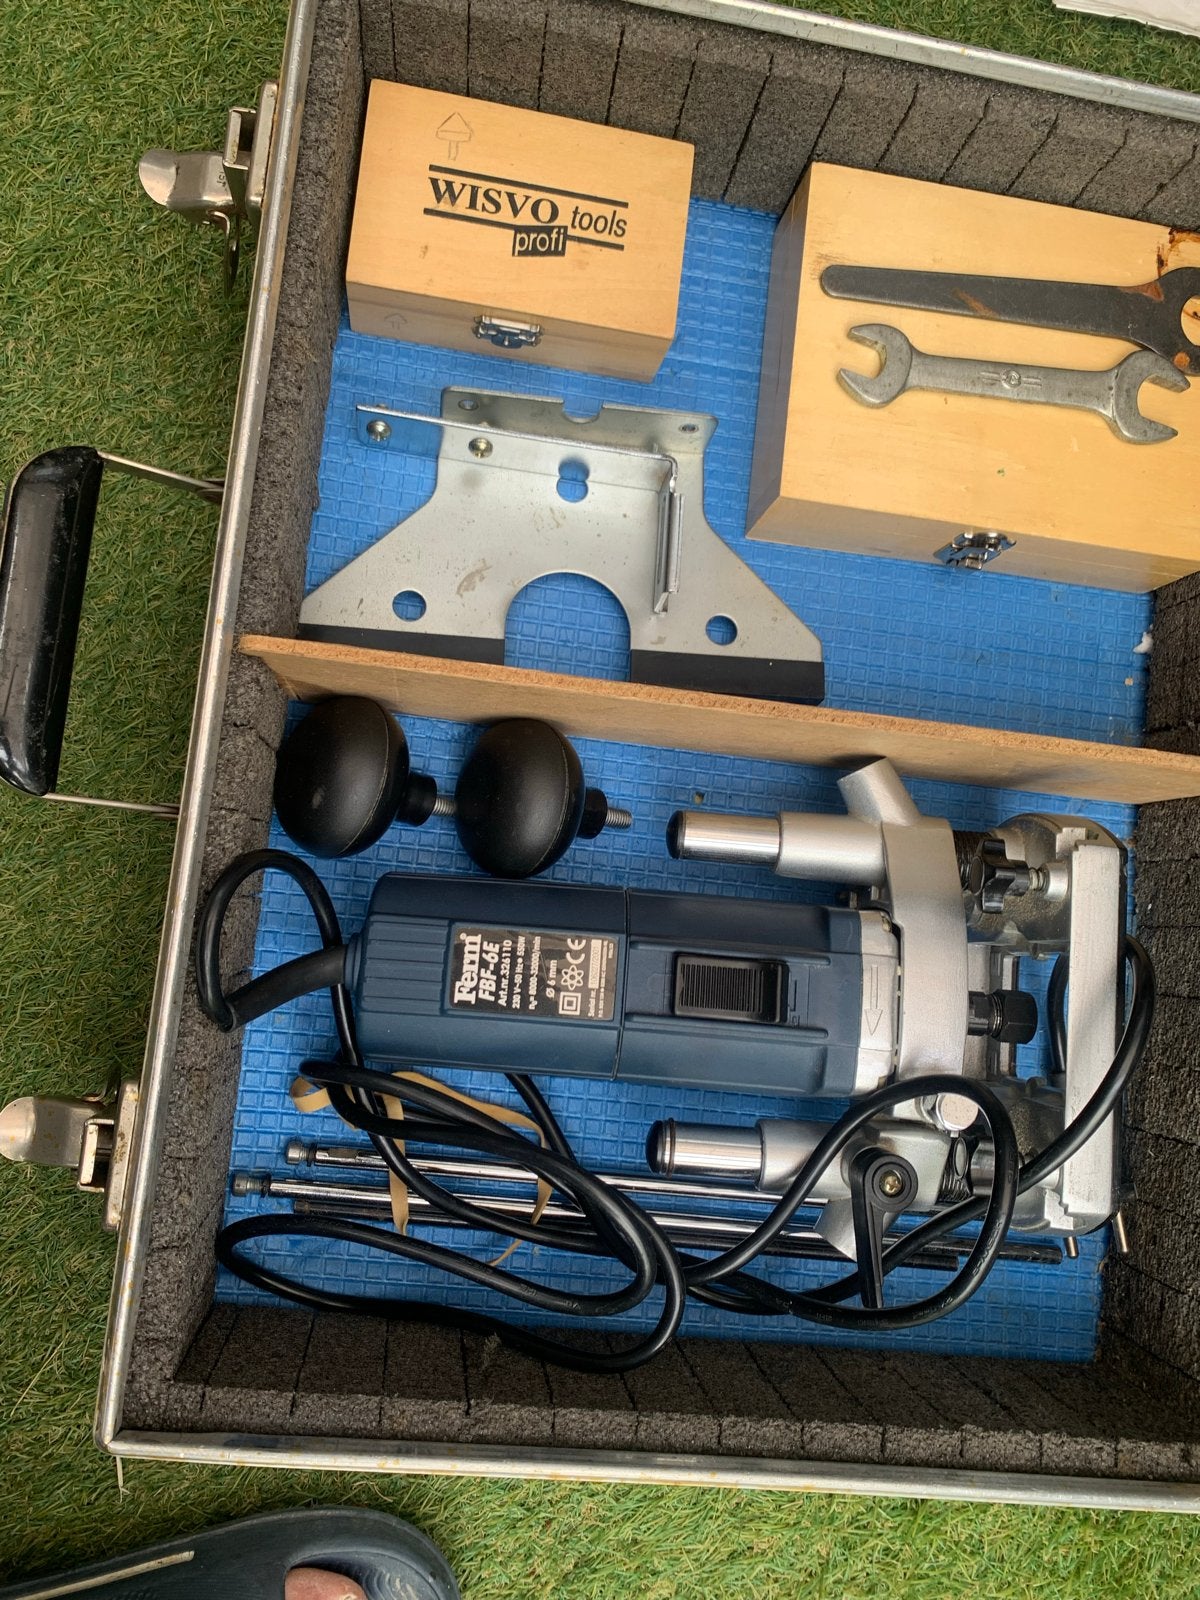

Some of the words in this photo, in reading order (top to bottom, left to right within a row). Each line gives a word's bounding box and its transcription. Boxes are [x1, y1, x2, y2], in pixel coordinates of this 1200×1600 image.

[428, 176, 559, 224] WISVO
[571, 205, 627, 238] tools
[514, 228, 565, 256] profi
[454, 934, 481, 1005] Ferm
[478, 941, 500, 1002] FBF-6E
[549, 960, 557, 978] mm
